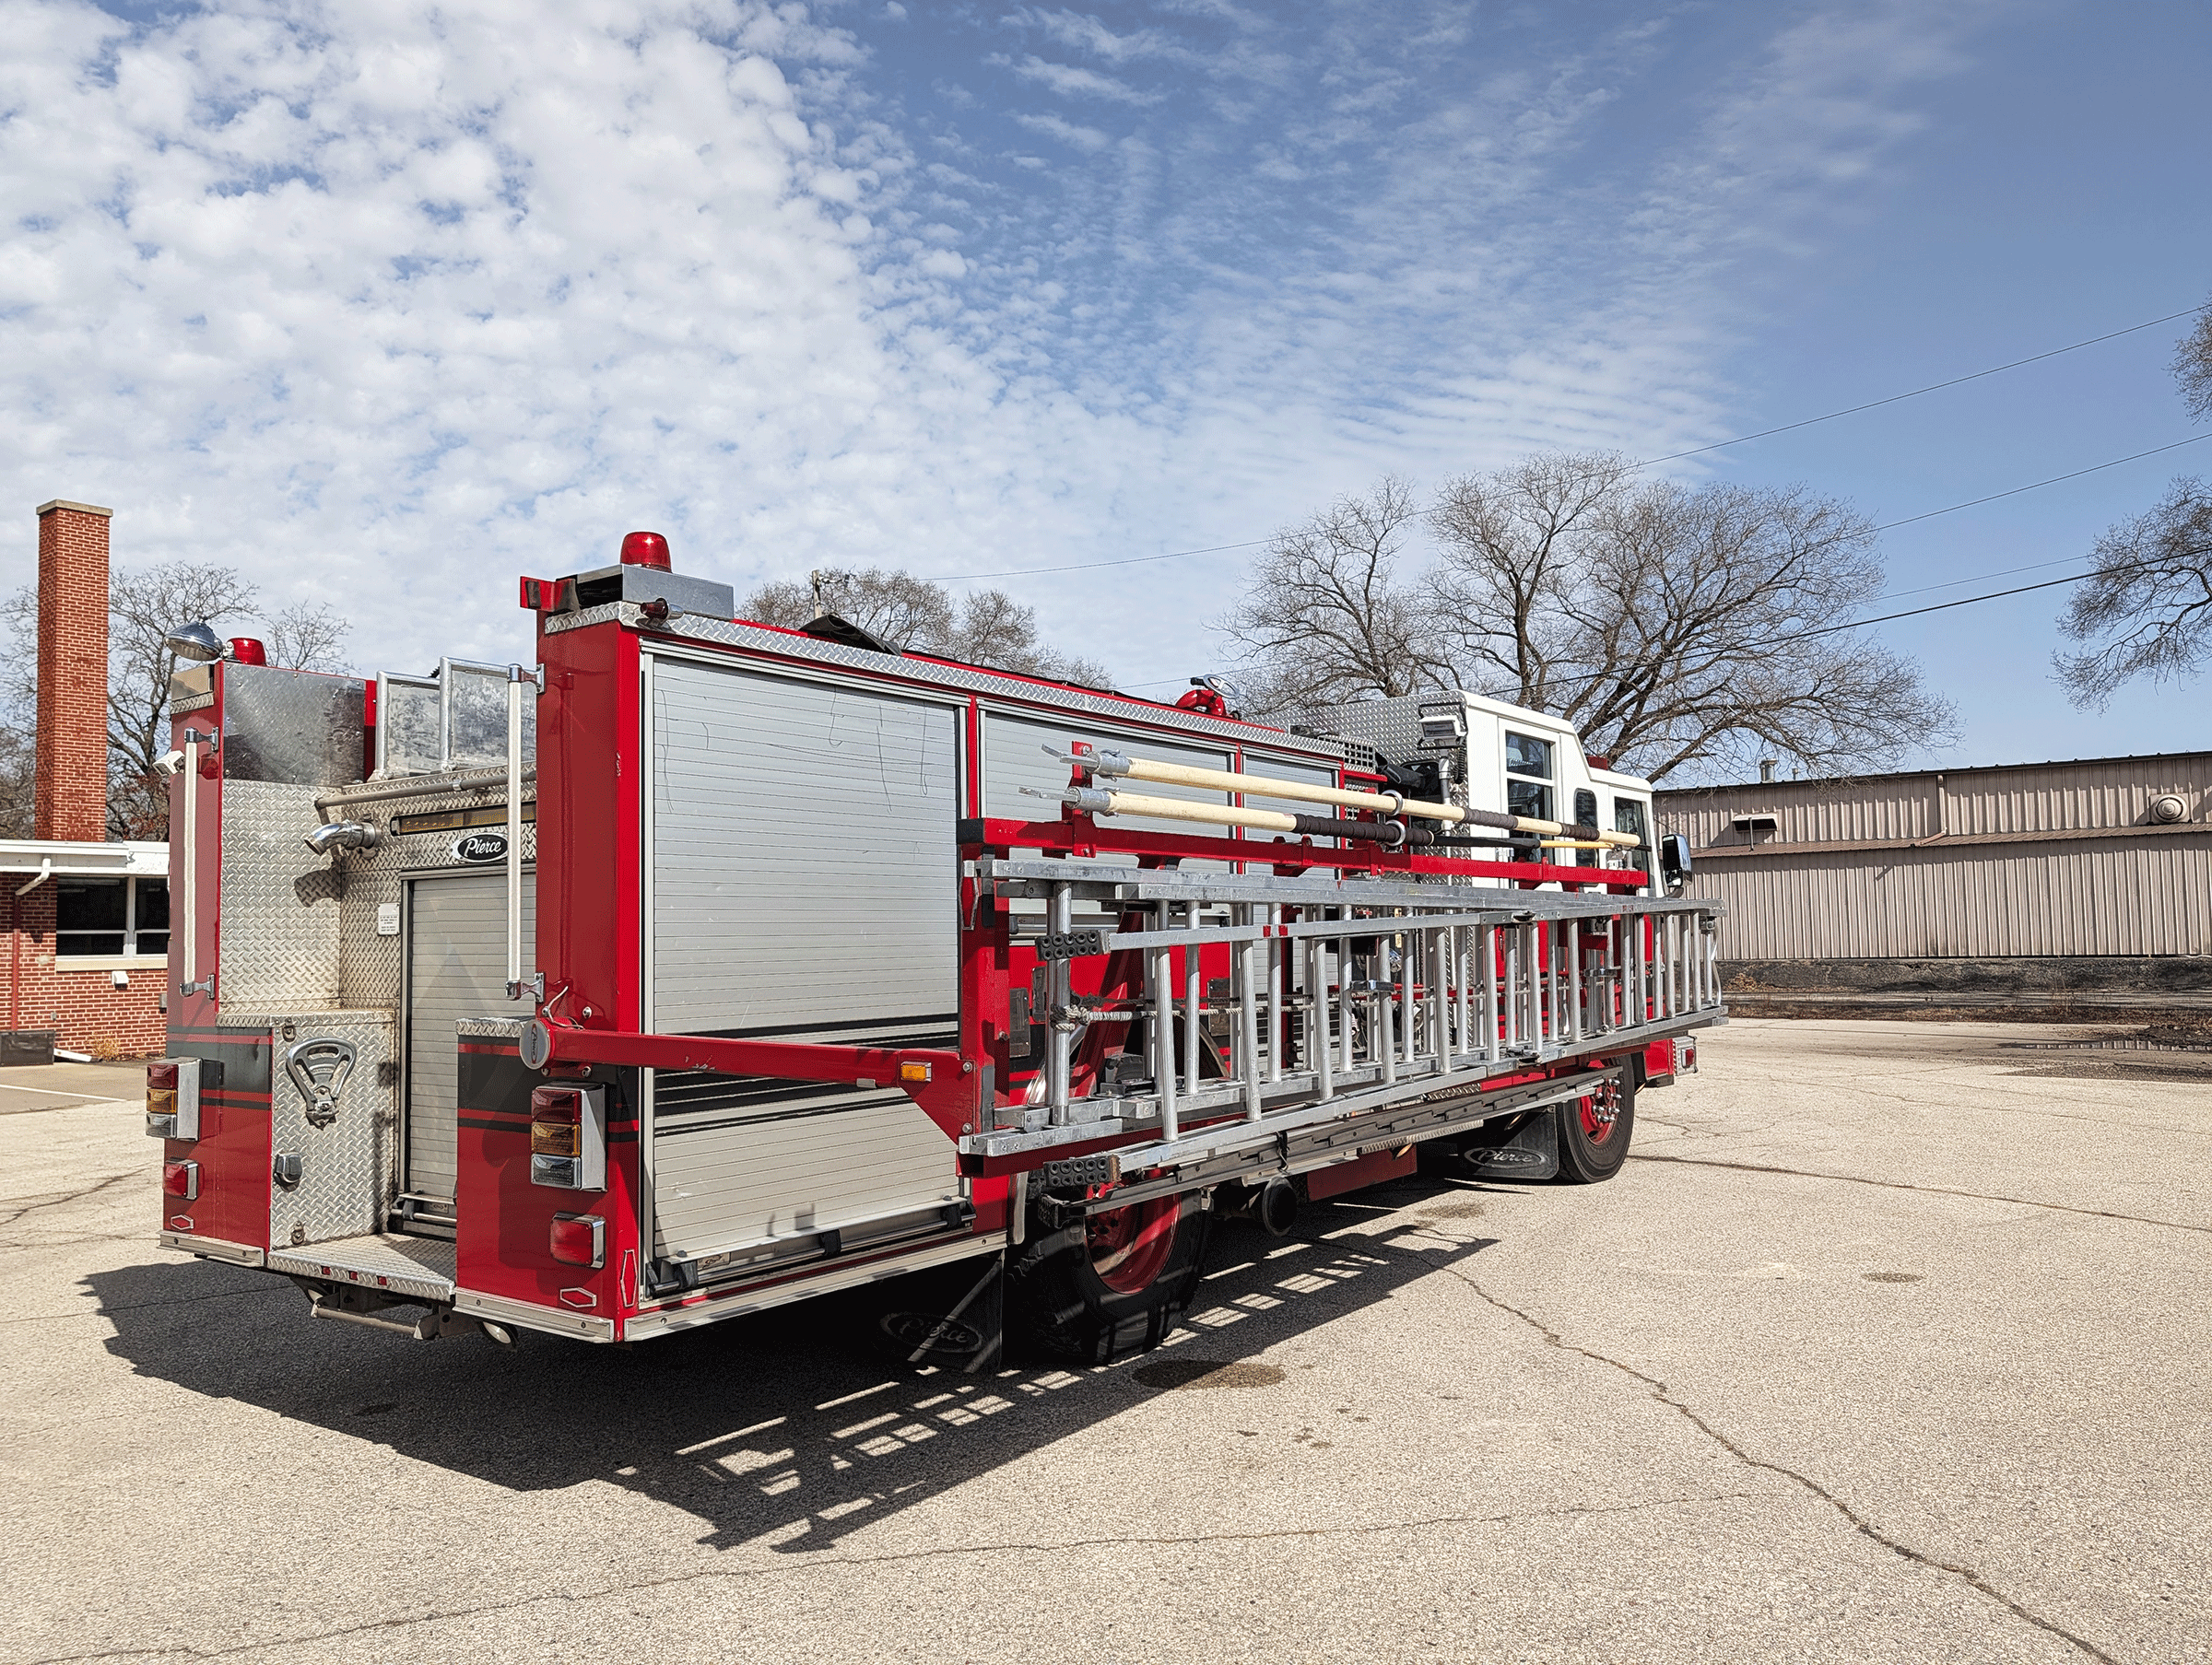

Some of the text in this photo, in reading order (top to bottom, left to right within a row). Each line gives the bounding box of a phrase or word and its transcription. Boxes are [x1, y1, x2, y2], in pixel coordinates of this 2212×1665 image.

[464, 837, 502, 858] Pierce
[1477, 1149, 1533, 1162] Pierce
[899, 1317, 968, 1343] Pierce
